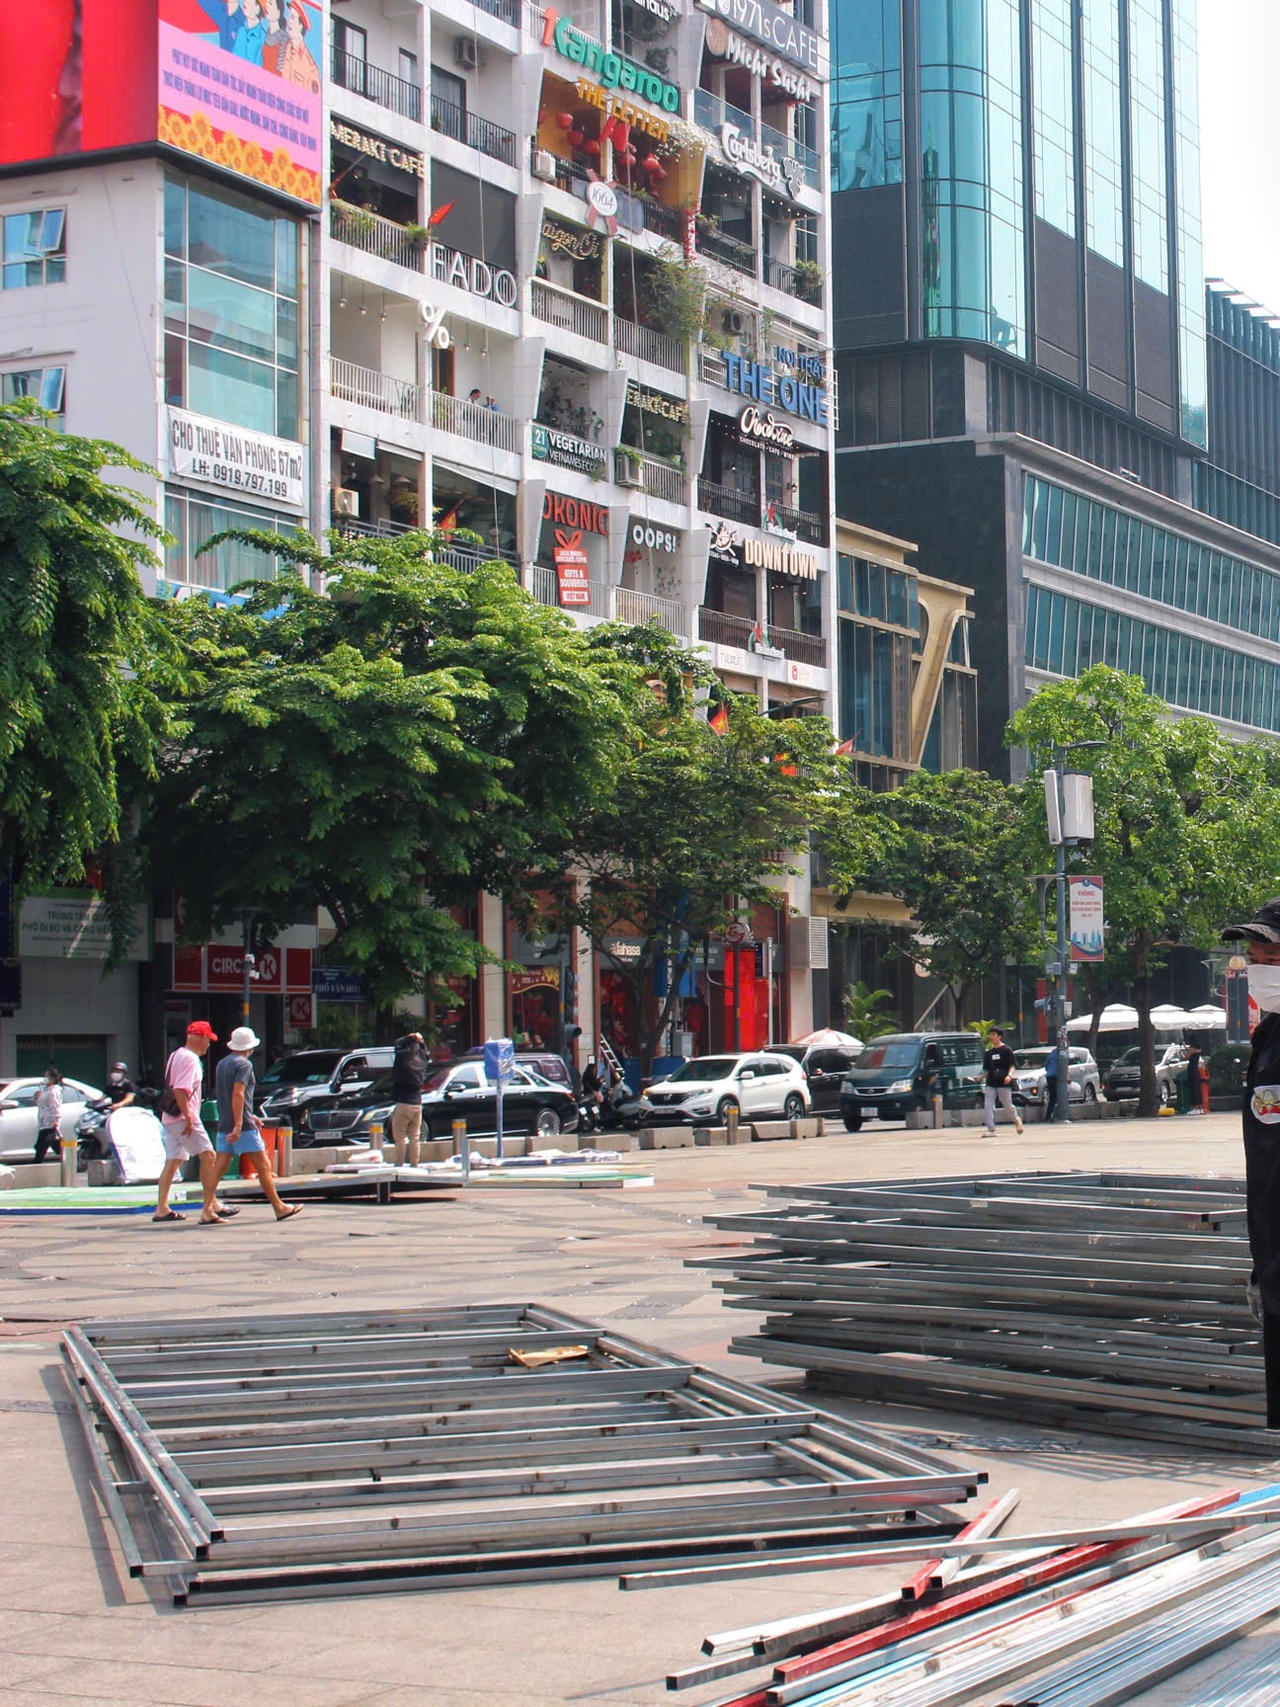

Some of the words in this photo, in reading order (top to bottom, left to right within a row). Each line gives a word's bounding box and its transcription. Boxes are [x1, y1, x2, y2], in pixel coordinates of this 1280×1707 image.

[773, 16, 817, 68] CAFE
[577, 75, 609, 111] THE
[612, 95, 670, 143] LETTER
[722, 122, 782, 185] Carlsberg
[591, 186, 615, 210] 1664
[431, 244, 518, 307] FADO
[721, 350, 773, 404] THE
[780, 376, 828, 427] ONE
[172, 419, 193, 451] CHO
[196, 426, 221, 458] THUÊ
[278, 449, 302, 481] 67m2
[535, 429, 545, 445] 21
[549, 432, 607, 462] VEGETARIAN
[192, 458, 210, 476] LH:
[213, 463, 288, 497] 0919.797.199
[632, 524, 676, 553] OOPS!
